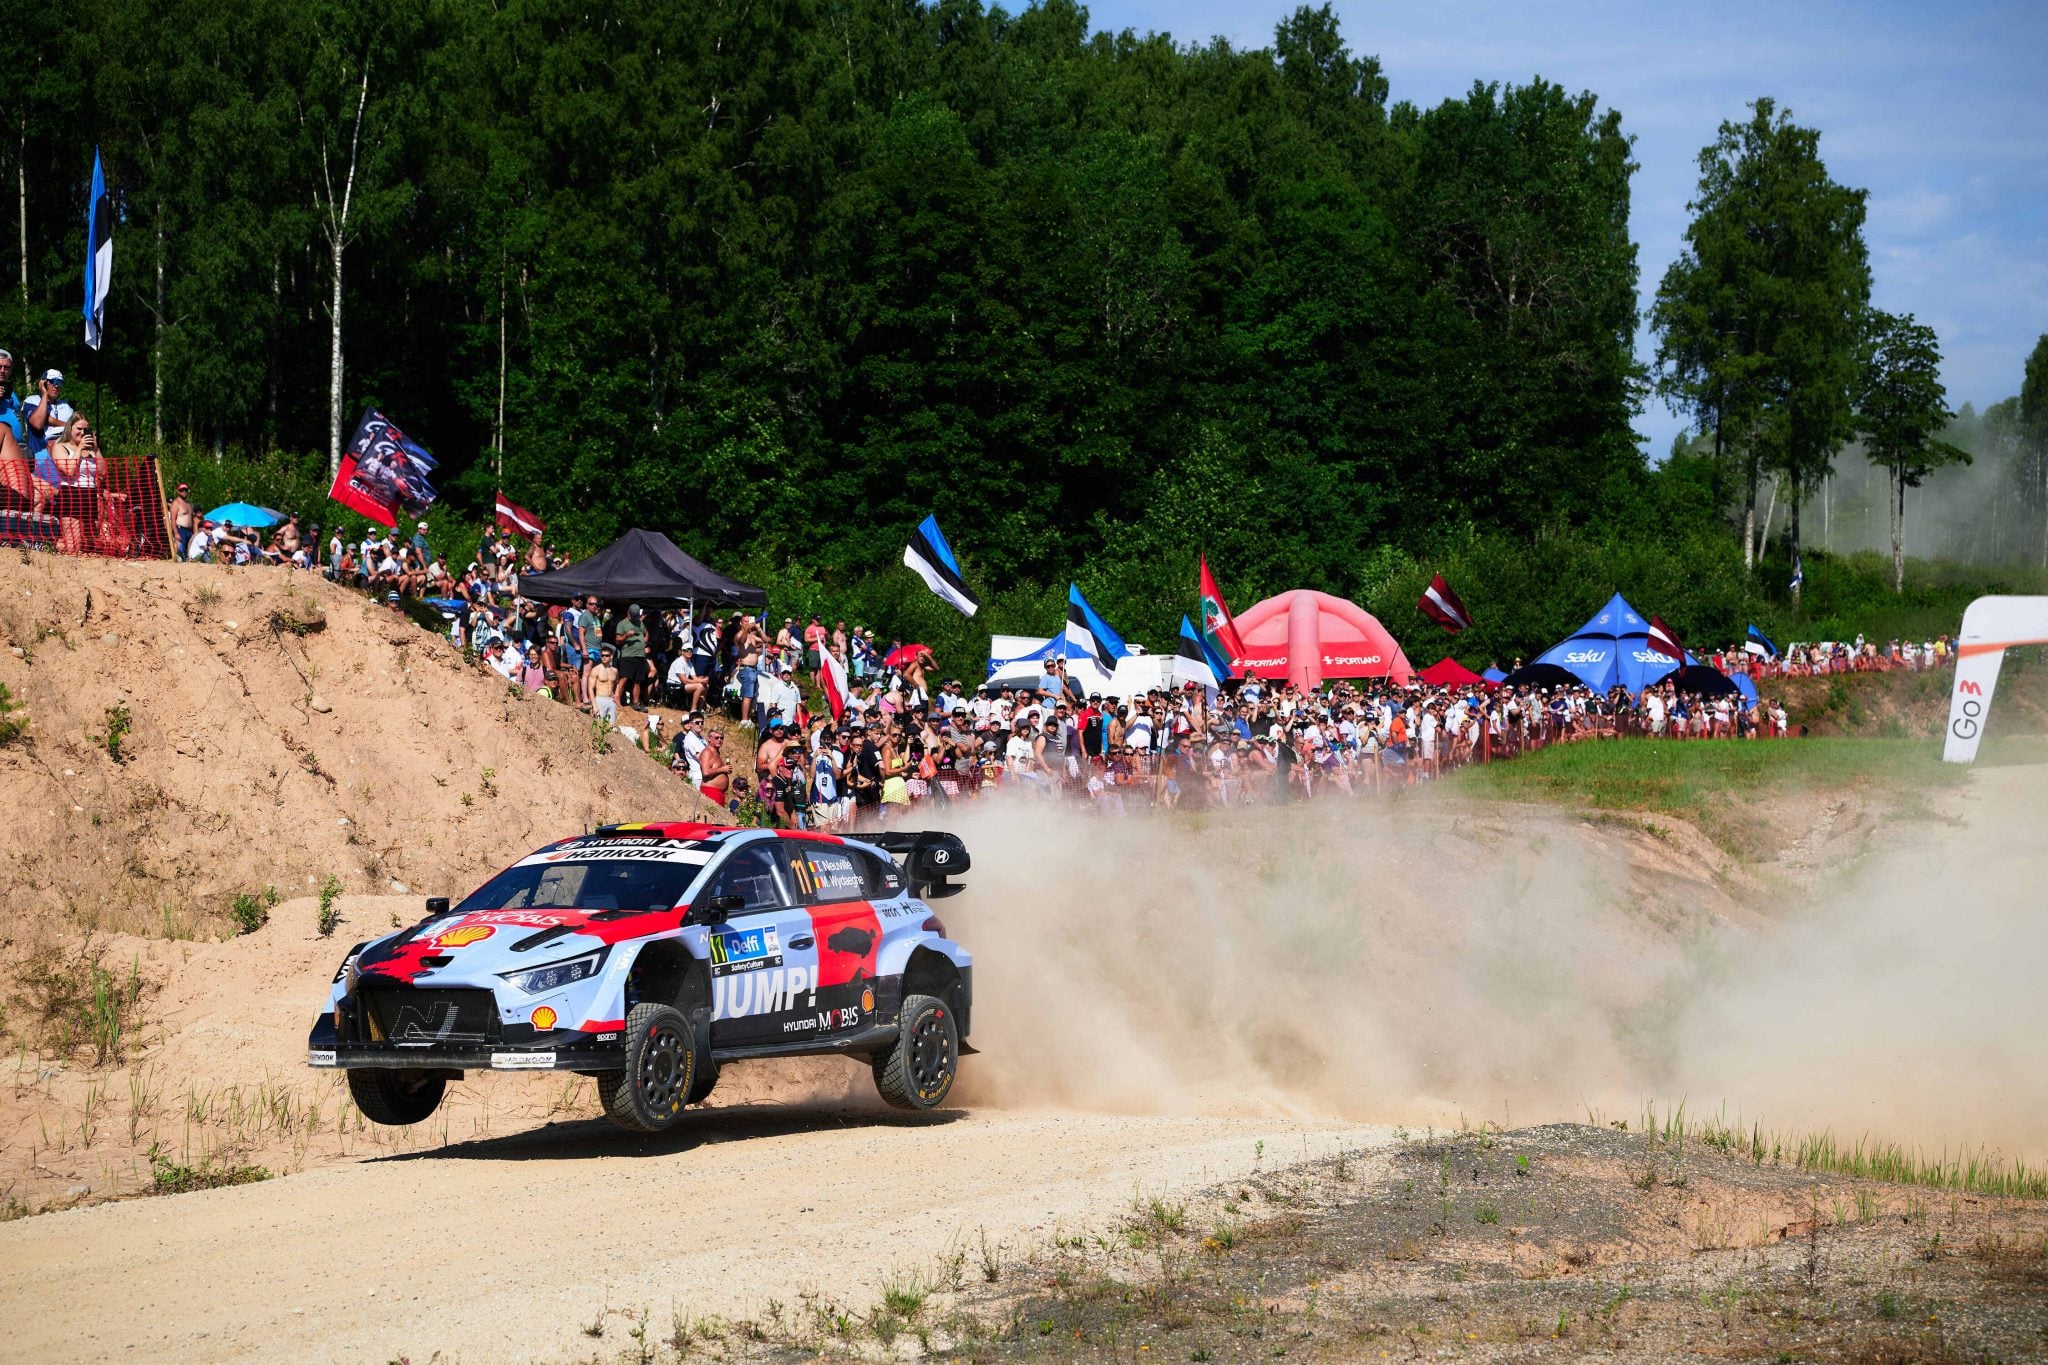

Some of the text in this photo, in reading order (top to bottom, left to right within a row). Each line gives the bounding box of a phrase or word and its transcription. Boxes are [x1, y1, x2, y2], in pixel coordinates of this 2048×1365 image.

[1243, 656, 1287, 667] SPORTLAND
[1335, 655, 1381, 665] SPORTLAND
[585, 838, 658, 848] HYUNDAI
[822, 859, 853, 872] Neuville
[790, 859, 813, 895] 11
[829, 873, 864, 890] Wydaeghe
[731, 935, 760, 955] Delfi
[731, 961, 764, 972] SafetyCulture
[710, 965, 818, 1022] JUMP!
[783, 1005, 859, 1033] HYUNDAI MOBIS
